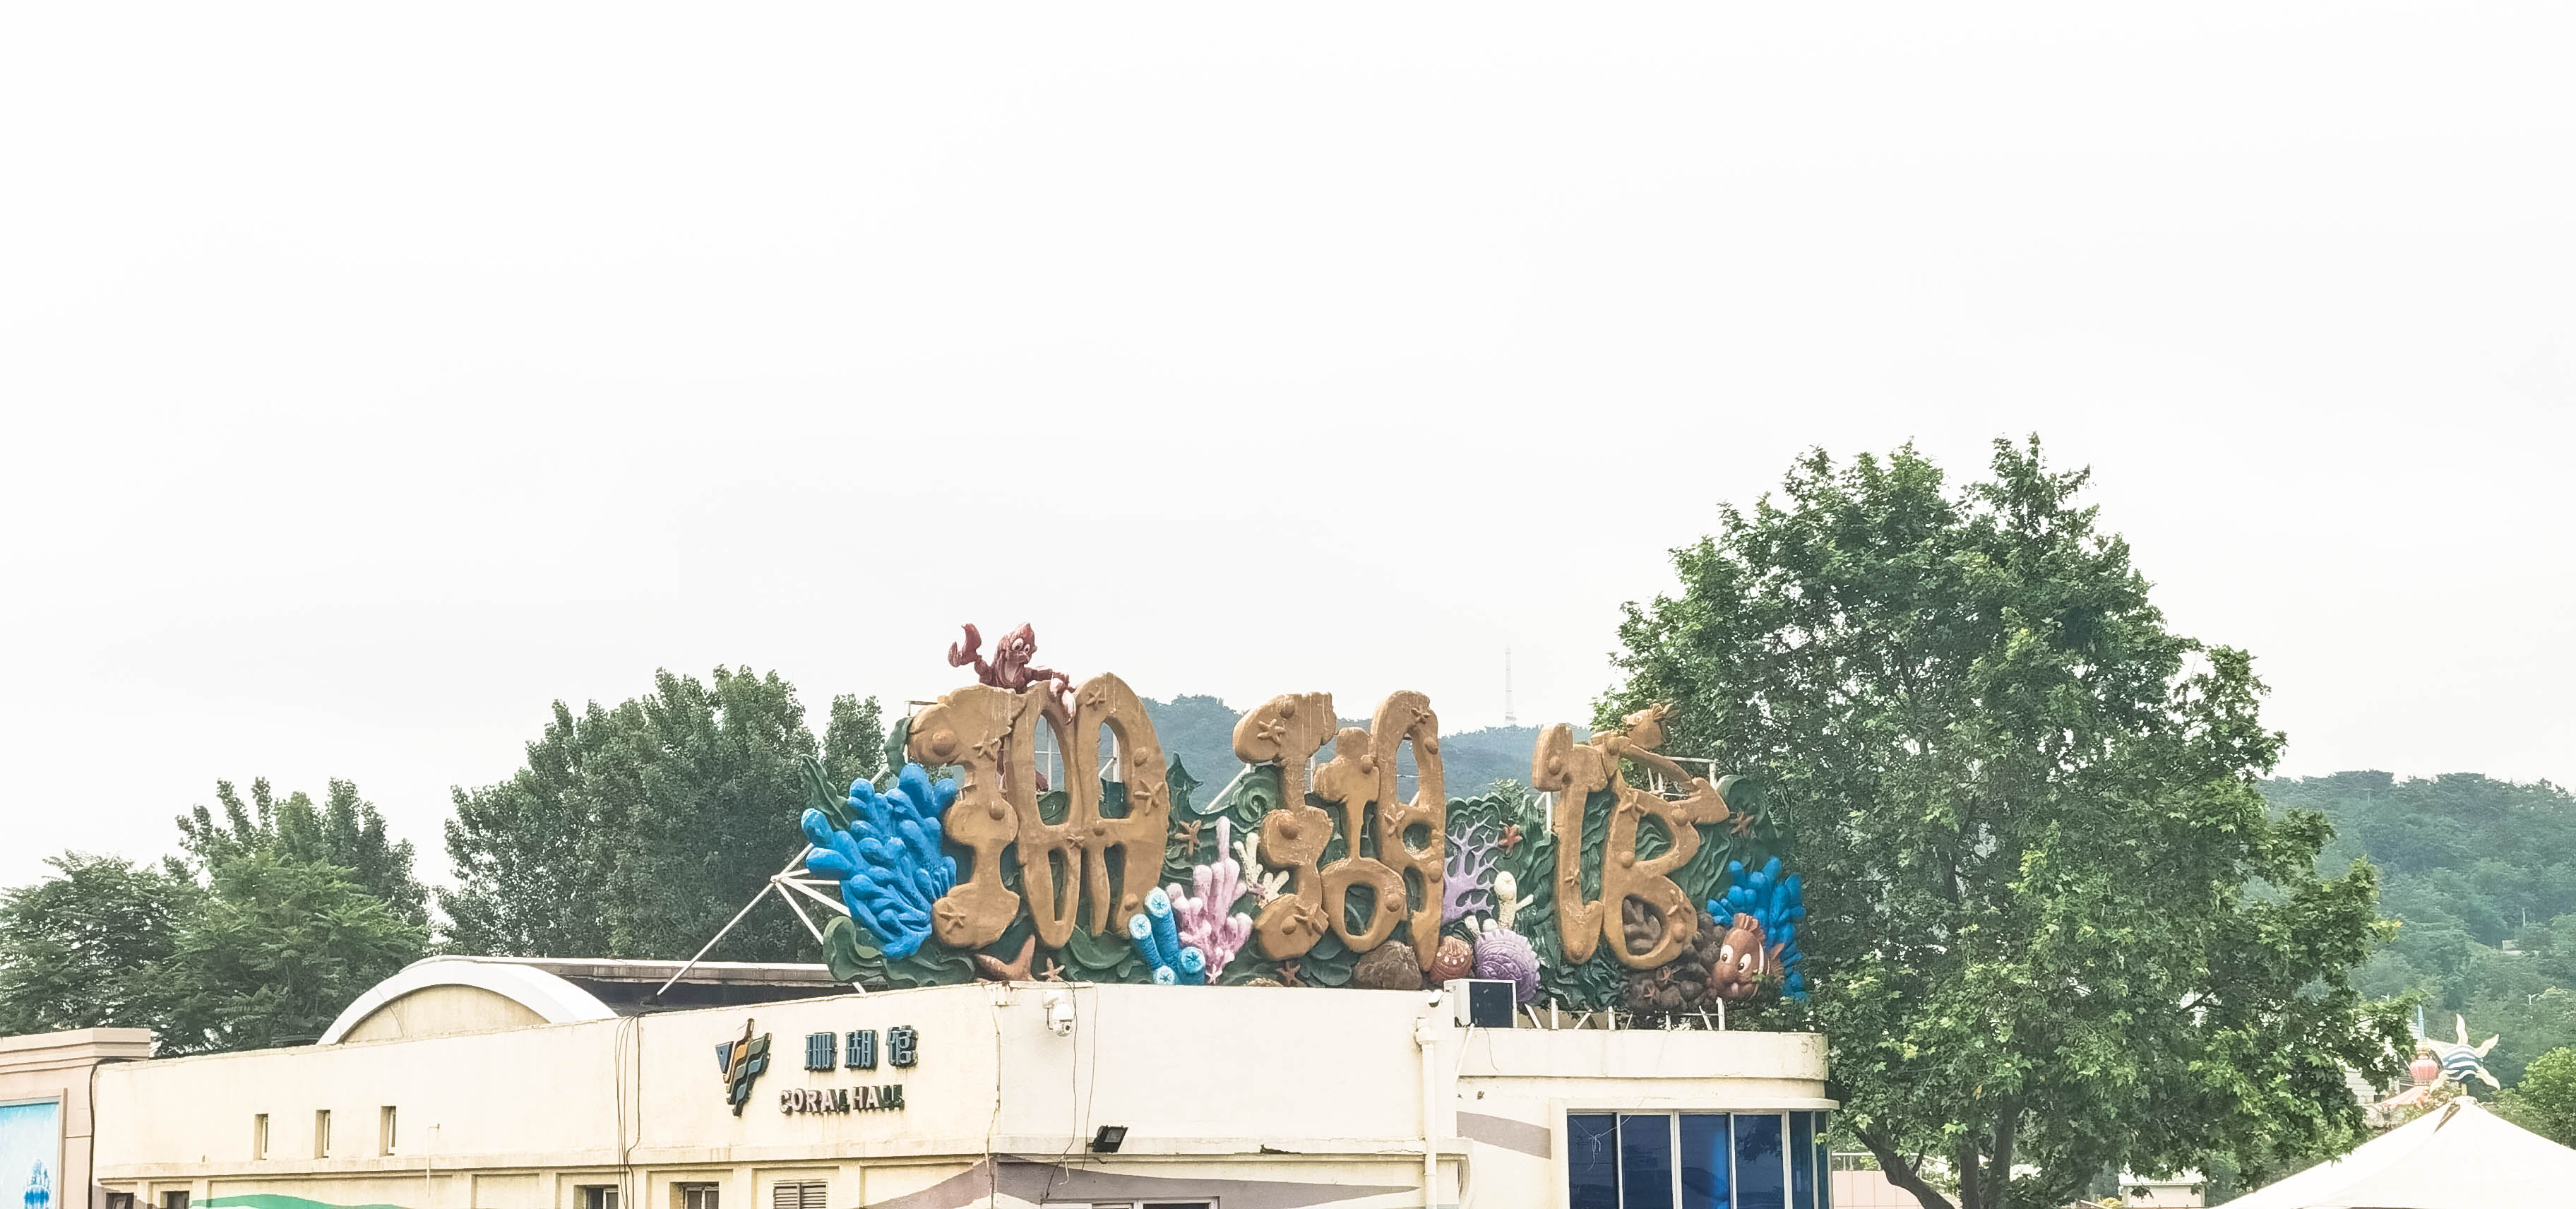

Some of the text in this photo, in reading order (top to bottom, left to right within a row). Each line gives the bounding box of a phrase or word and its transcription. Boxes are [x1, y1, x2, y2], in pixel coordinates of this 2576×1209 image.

[909, 672, 1729, 970] 珊瑚馆
[804, 1025, 919, 1071] 珊瑚馆
[778, 1084, 905, 1114] CORAL HALL
